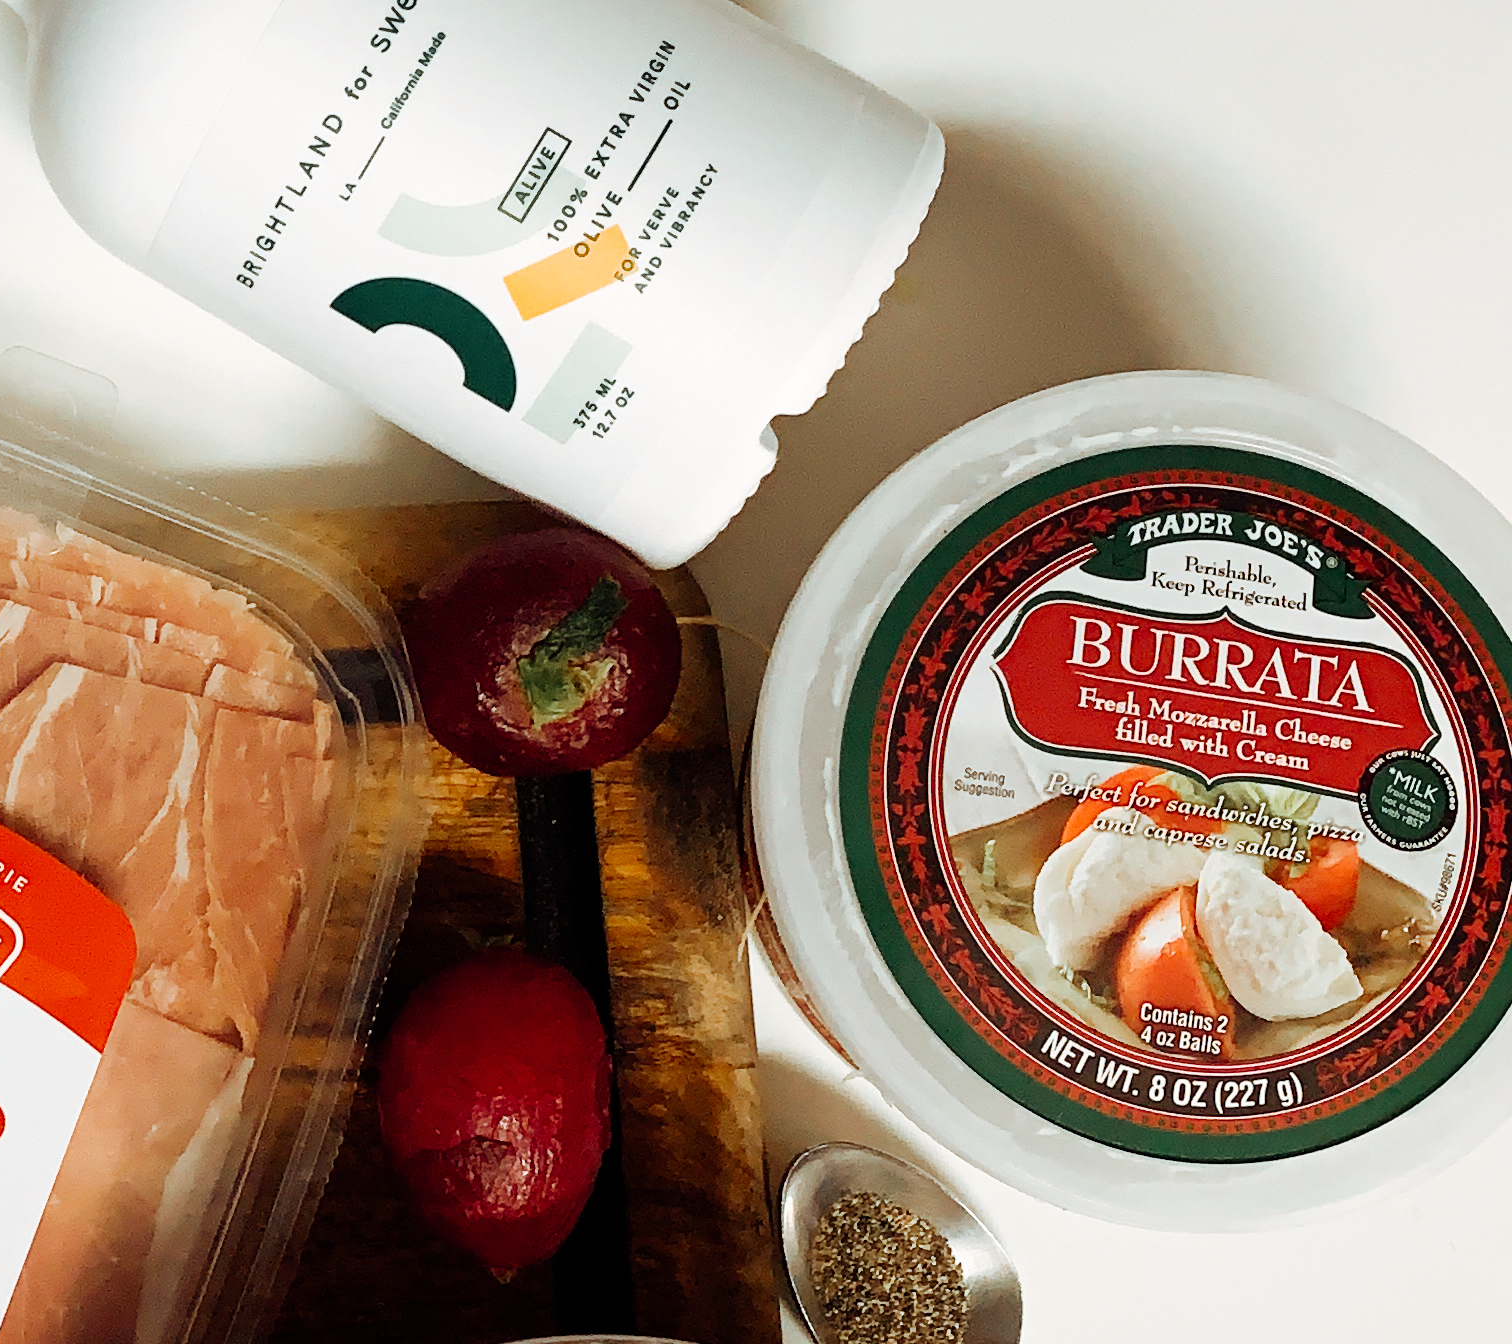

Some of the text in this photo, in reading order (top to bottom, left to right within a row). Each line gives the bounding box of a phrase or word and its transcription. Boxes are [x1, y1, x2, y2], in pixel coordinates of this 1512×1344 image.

[338, 30, 446, 201] LA California Made
[547, 40, 676, 242] 100% EXTRA VIRGIN
[236, 113, 344, 289] BRIGHTLAND
[344, 65, 373, 101] for
[514, 146, 556, 205] ALIVE
[574, 80, 691, 258] OLIVE OIL
[613, 186, 679, 282] FOR VERVE
[634, 163, 718, 294] AND VIBRANCY
[572, 378, 617, 428] 375 ML
[592, 386, 635, 439] 12.7 OZ
[1127, 512, 1325, 570] TRADER JOE'S
[1150, 570, 1307, 612] Keep Refrigerated
[1184, 555, 1277, 588] Perishable,
[1066, 615, 1375, 713] BURRATA
[1078, 686, 1353, 751] Fresh Mozzarella Cheese
[1115, 718, 1310, 771] filled with Cream
[964, 766, 1006, 787] Serving
[1410, 750, 1432, 763] JUST
[954, 778, 1015, 799] Suggestion
[1044, 772, 1365, 844] Perfect for sandwiches, pizza
[1386, 784, 1408, 801] from
[1092, 810, 1312, 864] and caprese salads.
[1140, 1002, 1229, 1034] Contains 2
[1140, 1026, 1222, 1055] 4 oz Balls
[1041, 1029, 1304, 1114] NET WT. 8 OZ (227 g)
